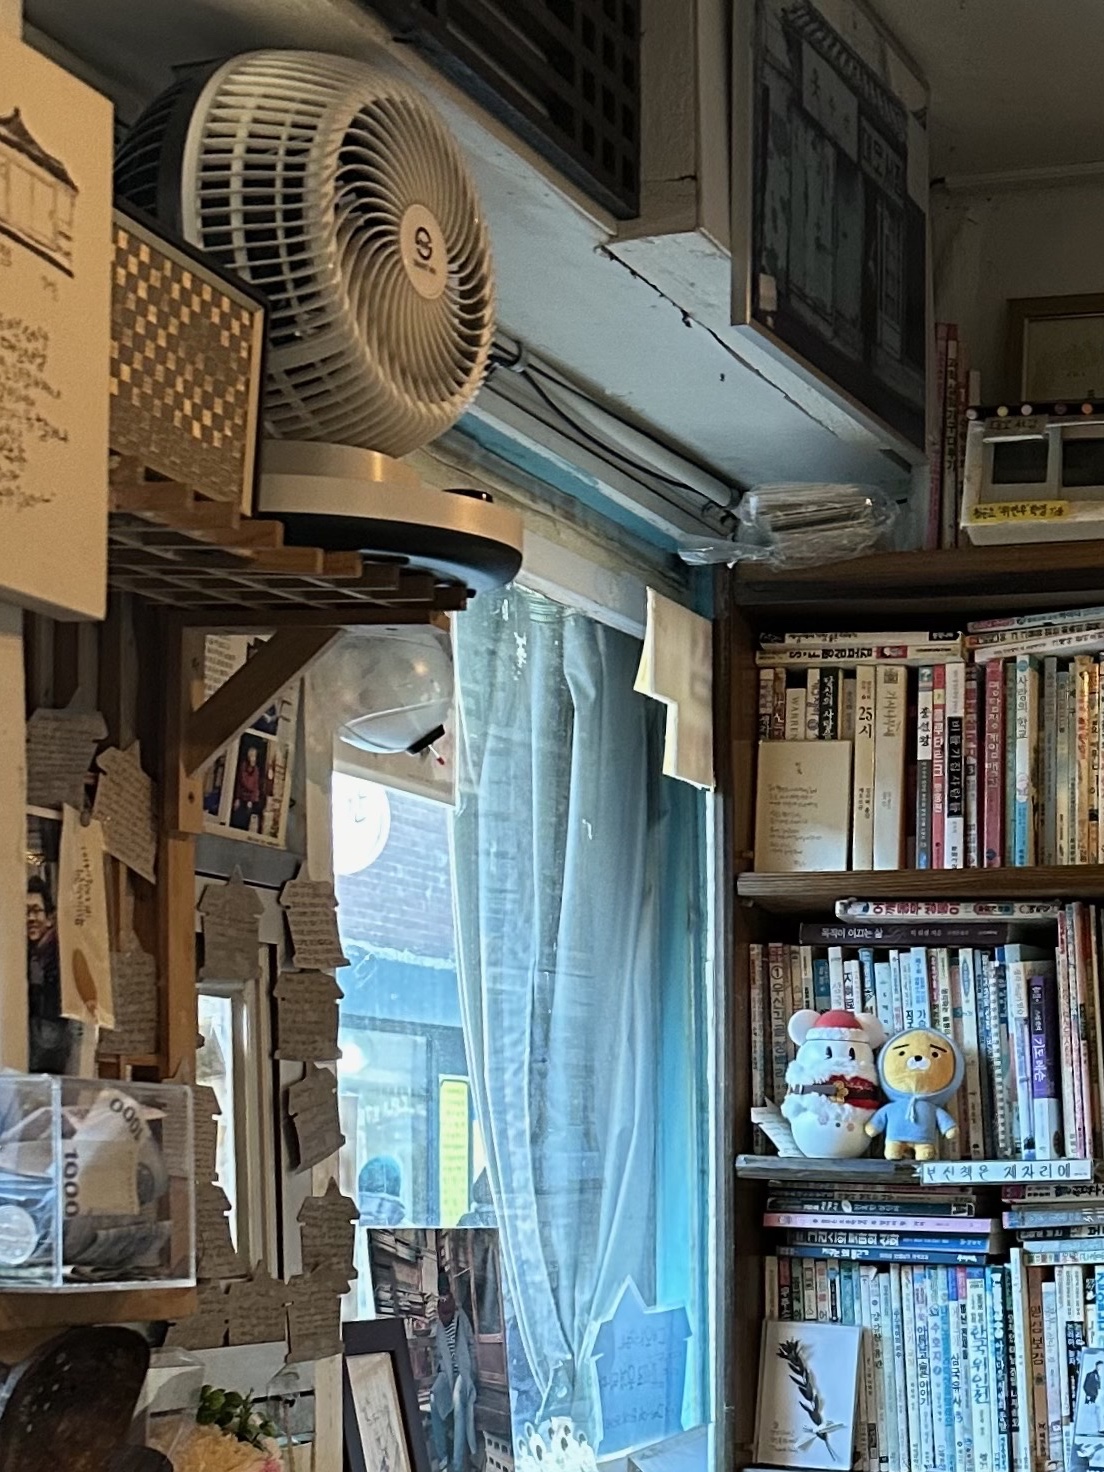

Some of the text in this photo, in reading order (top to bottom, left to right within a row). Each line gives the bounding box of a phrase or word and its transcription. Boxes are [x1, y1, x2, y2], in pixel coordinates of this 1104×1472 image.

[63, 1148, 79, 1218] 1000
[1003, 1162, 1071, 1180] 제자리에
[970, 1325, 989, 1404] 한국위인전
